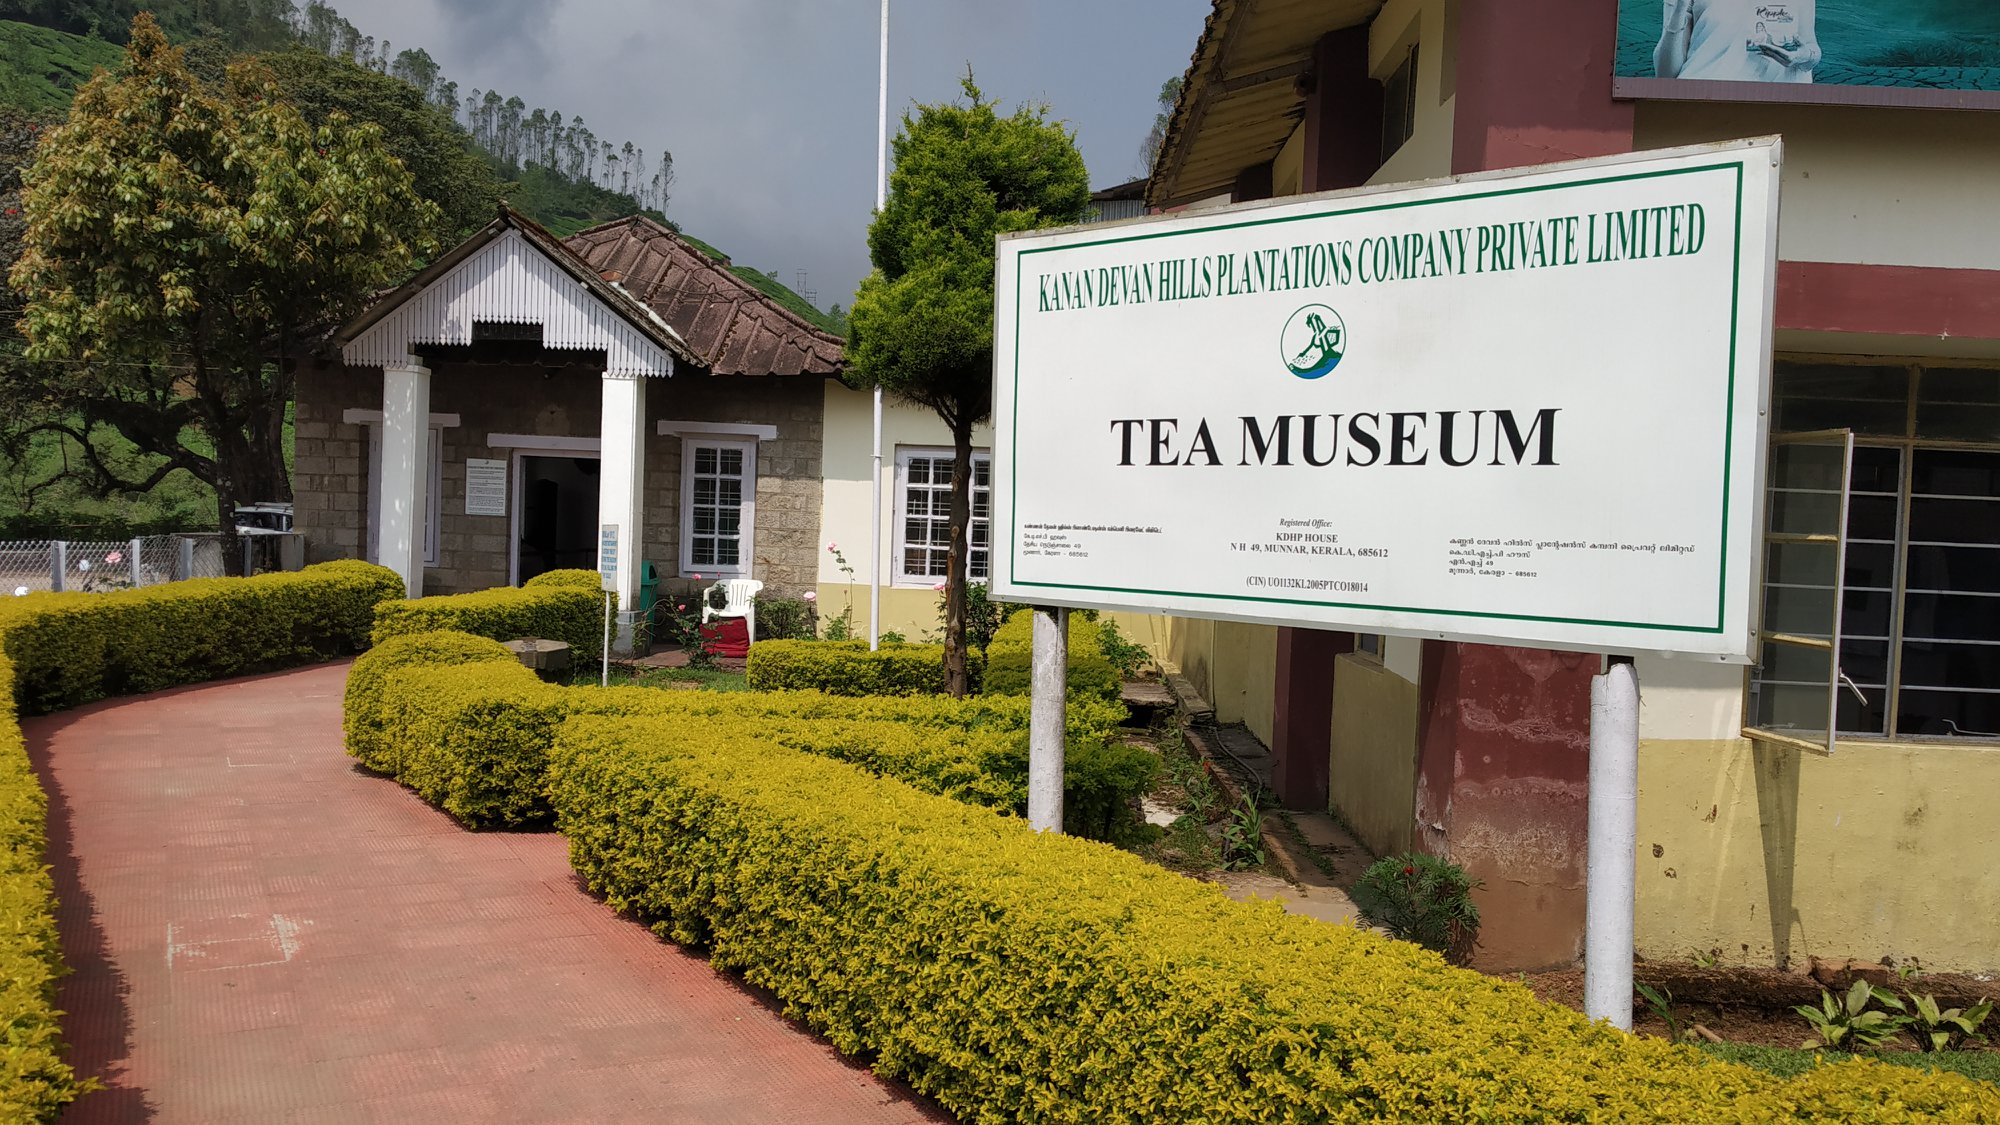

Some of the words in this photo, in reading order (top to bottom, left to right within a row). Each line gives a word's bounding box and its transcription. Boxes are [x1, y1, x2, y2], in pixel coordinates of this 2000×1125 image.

[1038, 269, 1095, 312] KANAN
[1098, 262, 1155, 307] DEVAN
[1158, 255, 1212, 302] HILLS
[1216, 240, 1353, 297] PLANTATIONS
[1358, 227, 1472, 284] COMPANY
[1475, 216, 1579, 274] PRIVATE
[1586, 203, 1706, 264] LIMITED
[1110, 416, 1223, 467] TEA
[1237, 408, 1561, 467] MUSEUM
[1279, 518, 1311, 528] Registered
[1311, 519, 1333, 529] Office:
[1276, 532, 1303, 543] KDHP
[1305, 534, 1338, 544] HOUSE
[1250, 543, 1263, 553] 49,
[1264, 544, 1309, 555] MUNNAR,
[1311, 545, 1356, 557] KERALA,
[1357, 547, 1389, 558] 685612
[1246, 575, 1267, 587] (CIN)
